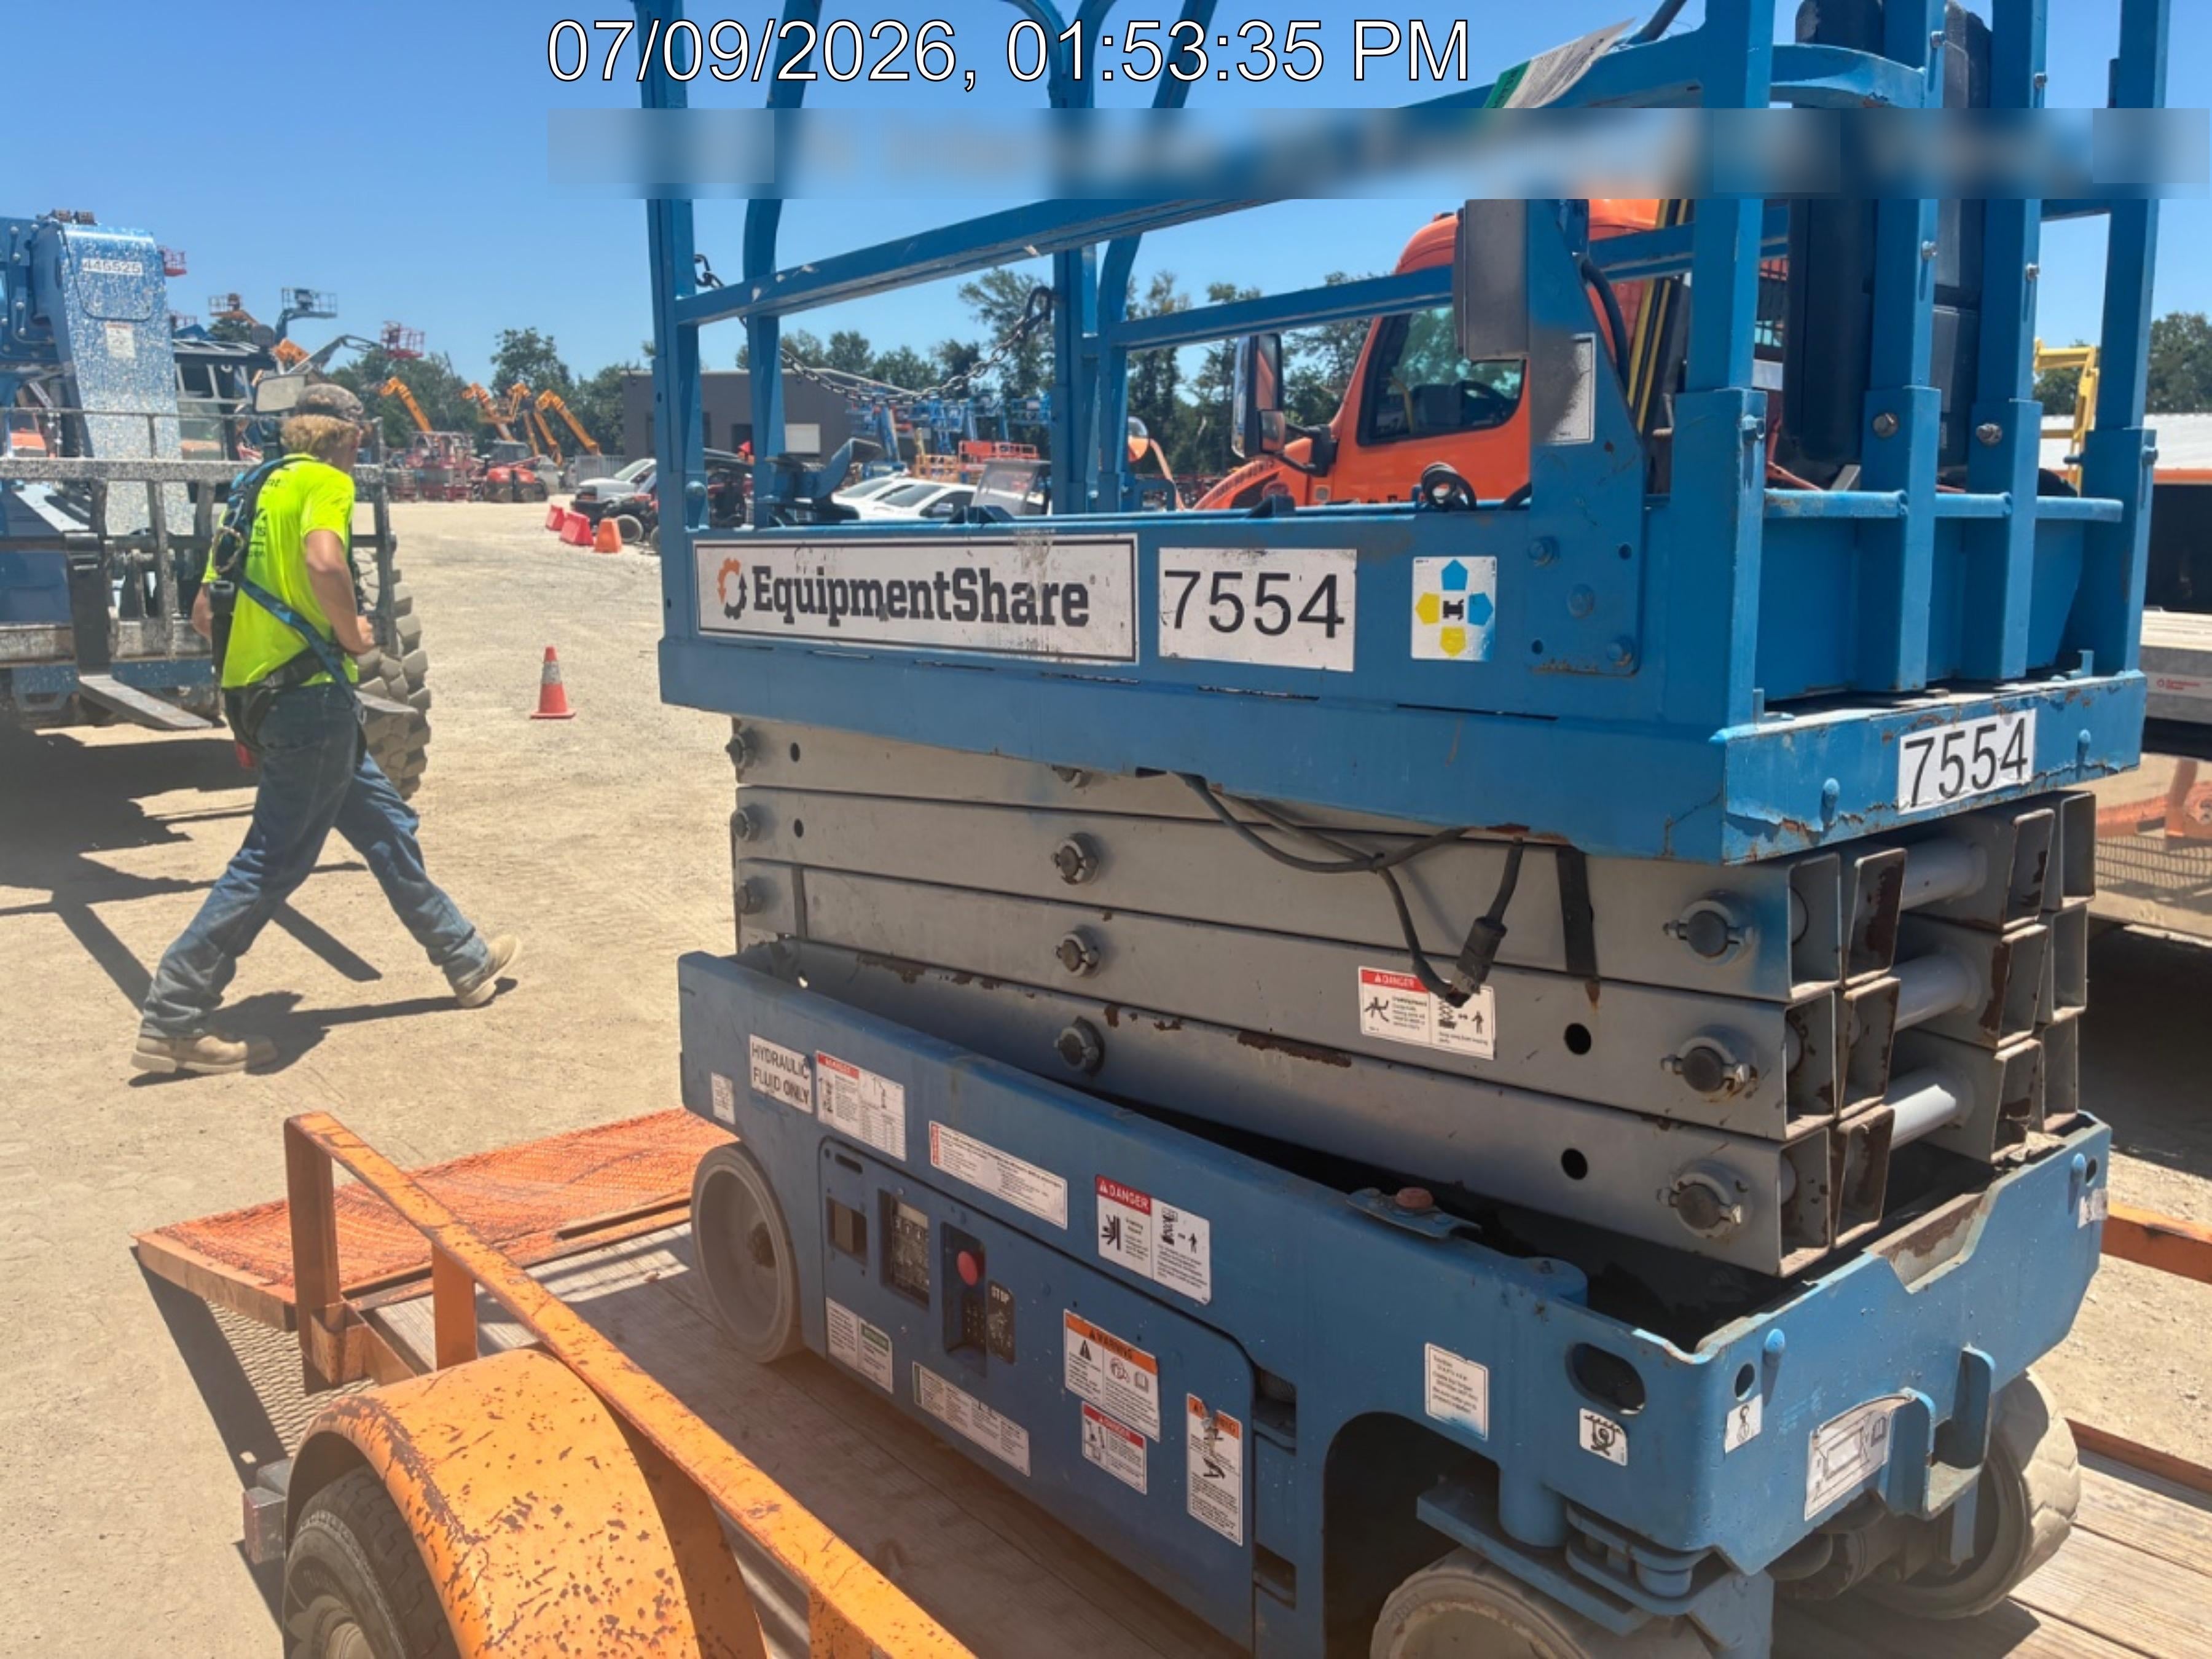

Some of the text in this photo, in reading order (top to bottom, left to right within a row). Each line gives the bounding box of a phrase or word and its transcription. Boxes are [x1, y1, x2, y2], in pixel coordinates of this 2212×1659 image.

[751, 565, 1089, 627] EquipmentShare
[1164, 570, 1345, 638] 7554
[1904, 717, 2028, 807] 7554
[753, 1066, 780, 1091] FLUID
[783, 1079, 810, 1105] ONLY
[1108, 1183, 1149, 1210] DANGER
